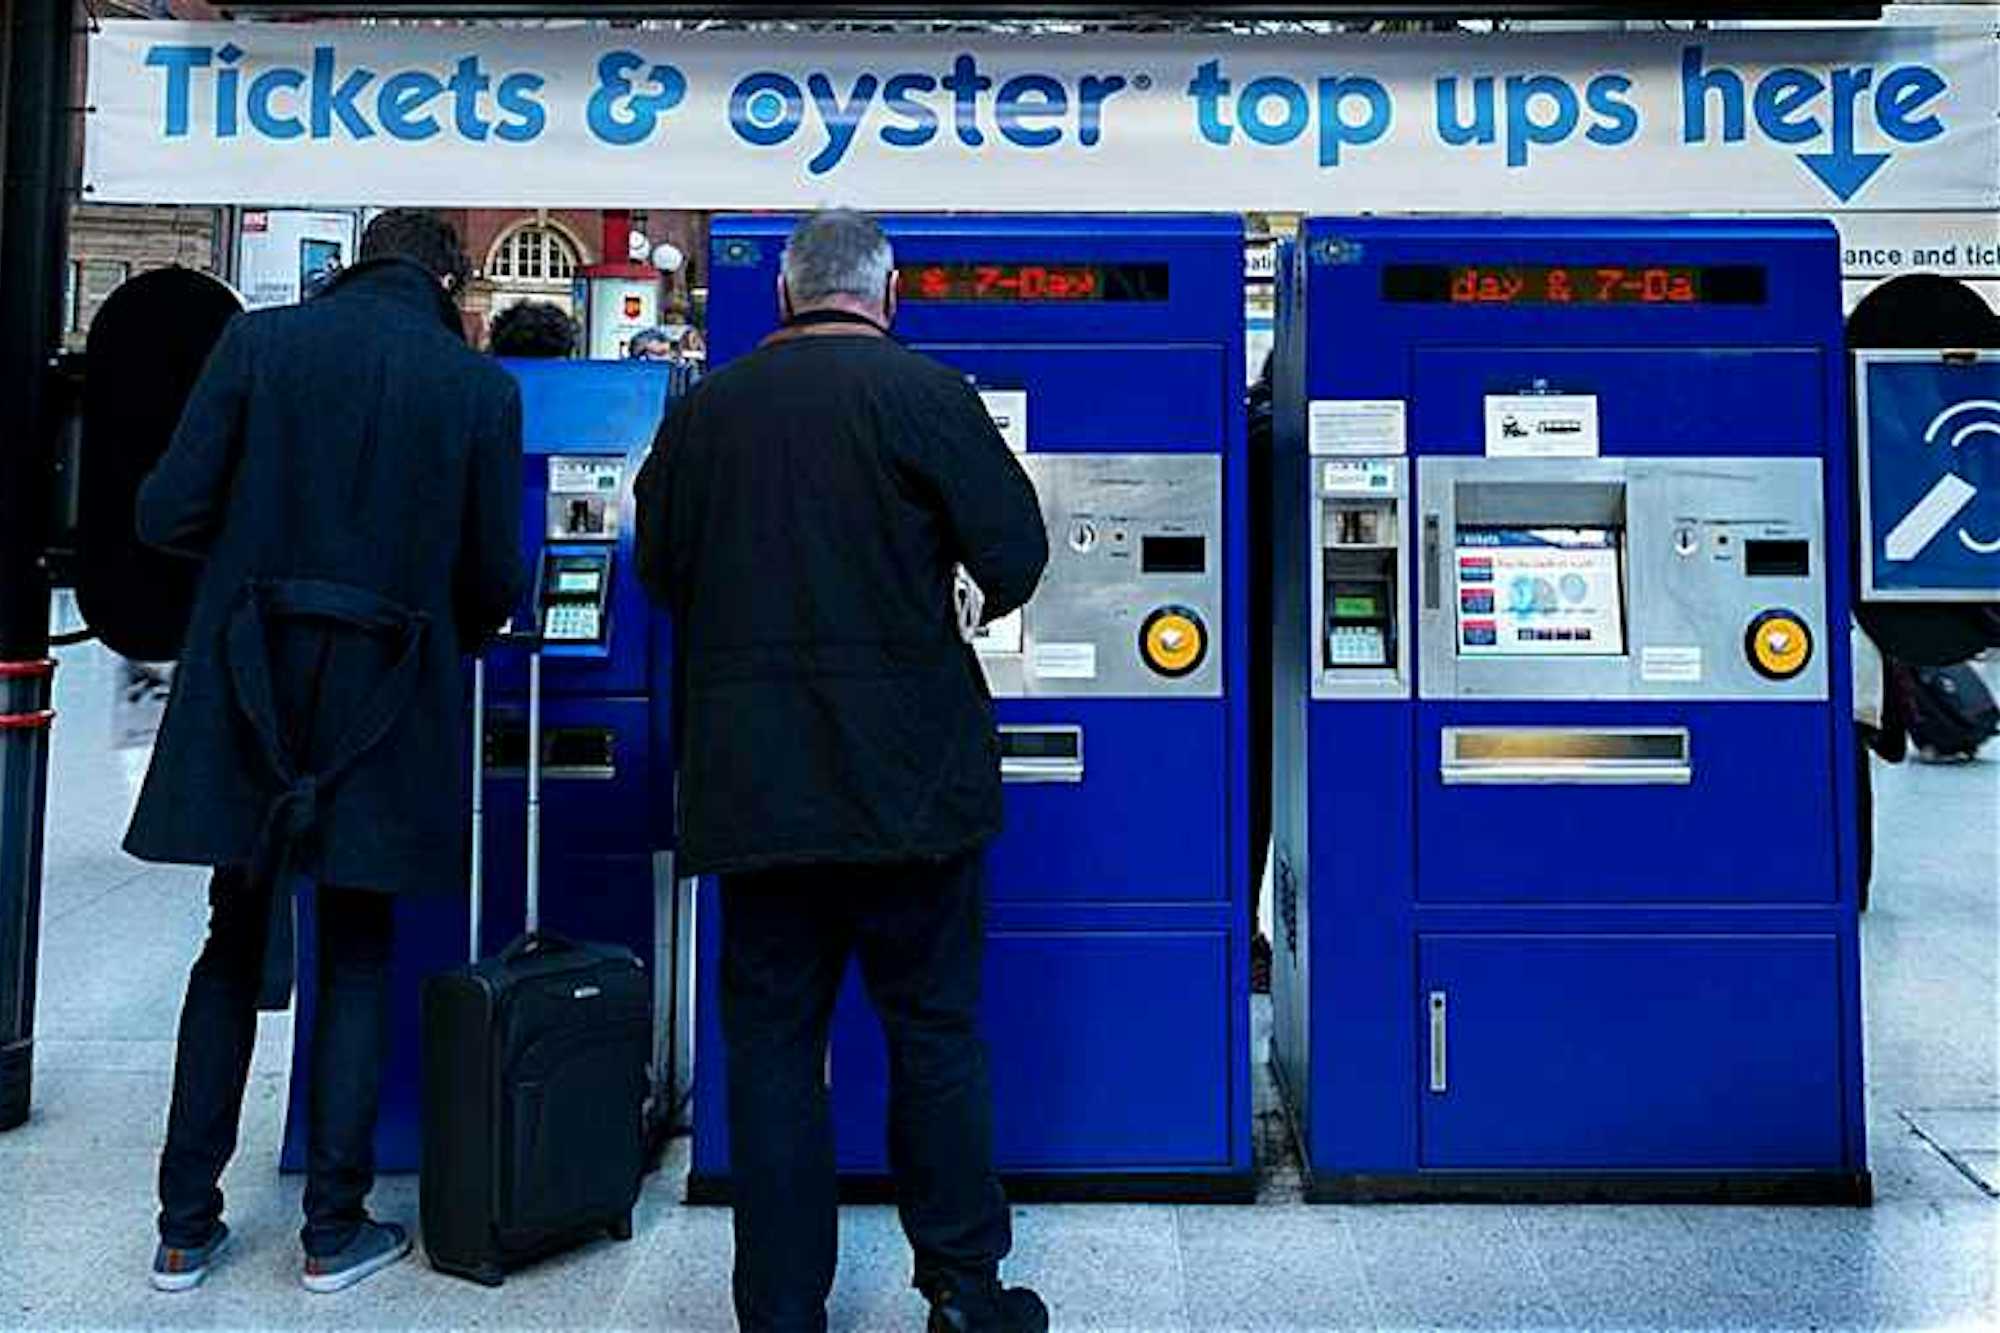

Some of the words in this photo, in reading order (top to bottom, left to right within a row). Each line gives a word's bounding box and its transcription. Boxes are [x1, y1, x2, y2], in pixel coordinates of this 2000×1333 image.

[143, 43, 546, 142] Tickets
[586, 50, 687, 145] &
[1187, 58, 1391, 167] top
[1436, 72, 1639, 167] ups
[1682, 46, 1948, 155] here
[1845, 249, 1901, 265] ance
[1913, 245, 1956, 265] and
[1452, 269, 1522, 302] day
[1548, 269, 1571, 300] &
